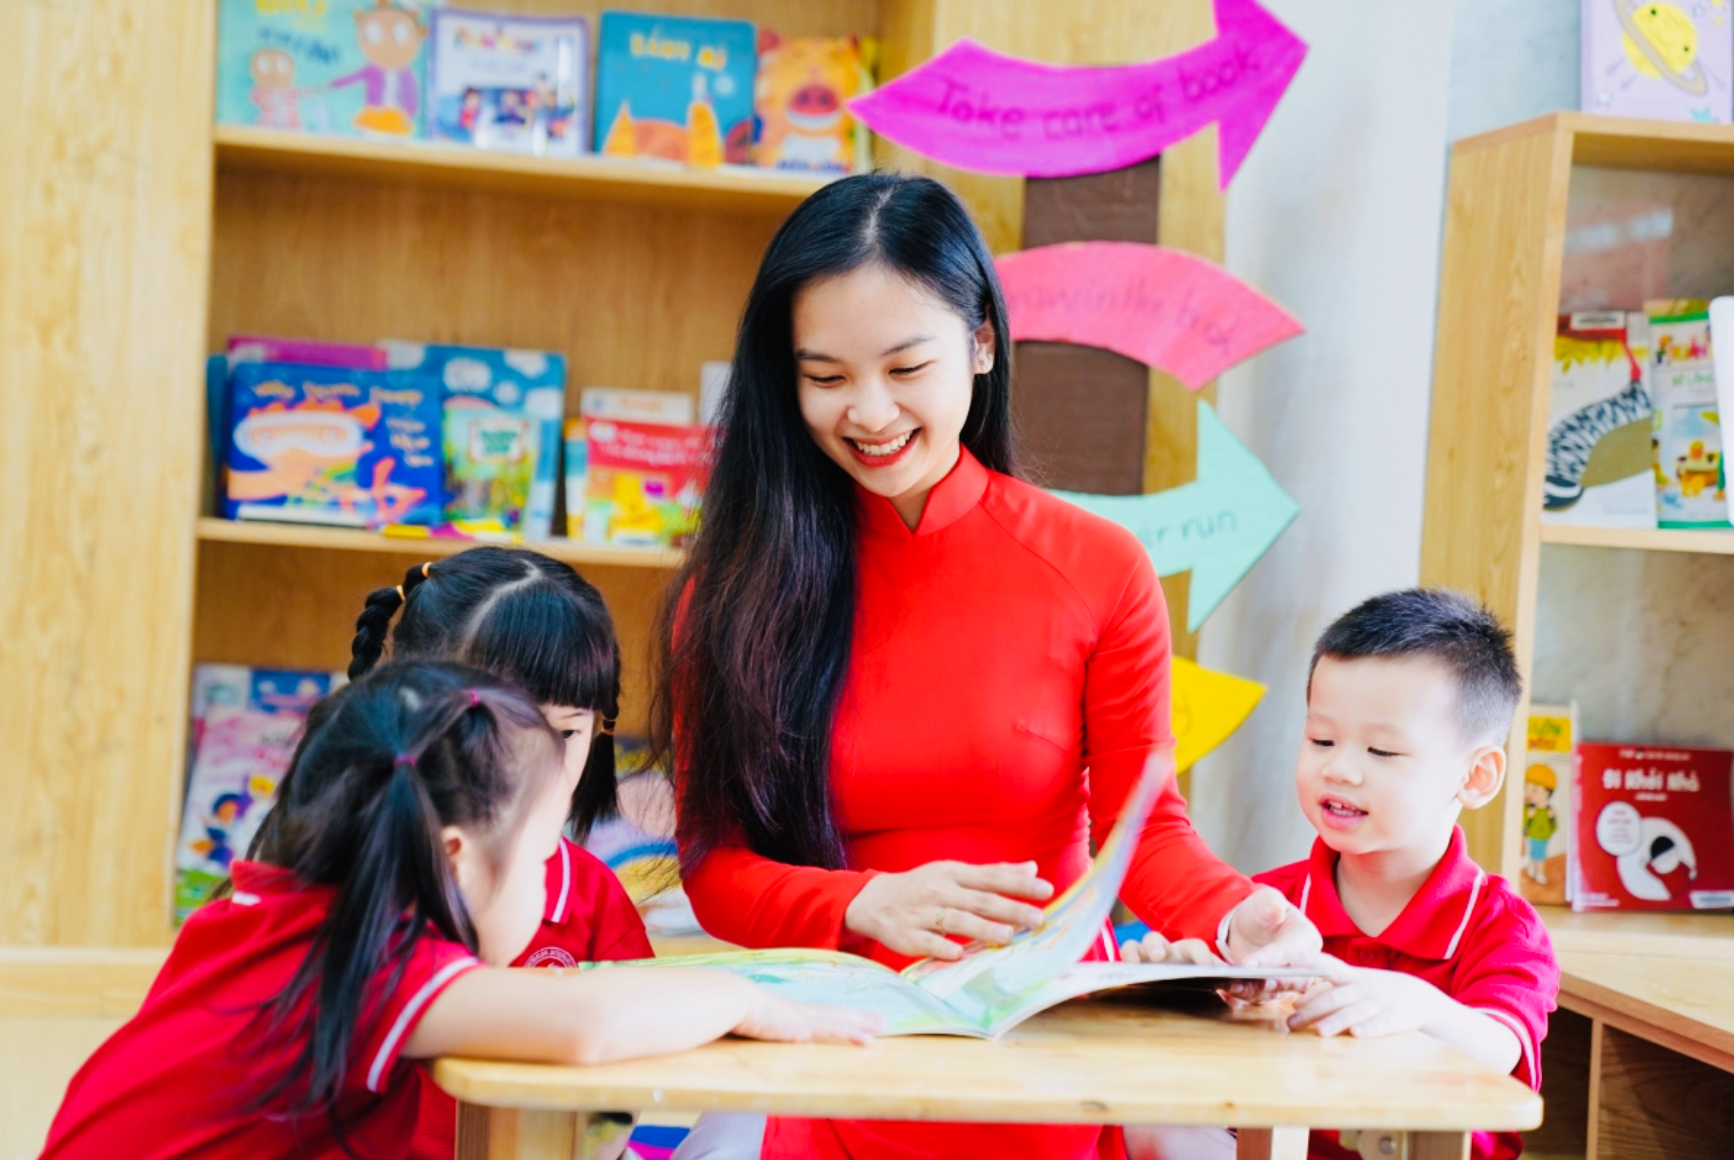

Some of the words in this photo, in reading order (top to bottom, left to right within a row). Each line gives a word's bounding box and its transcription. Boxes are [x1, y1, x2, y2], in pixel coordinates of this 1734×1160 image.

[938, 76, 1025, 140] Take
[1042, 101, 1121, 141] care
[1133, 82, 1165, 125] of
[1177, 40, 1260, 105] book
[1180, 507, 1239, 541] run
